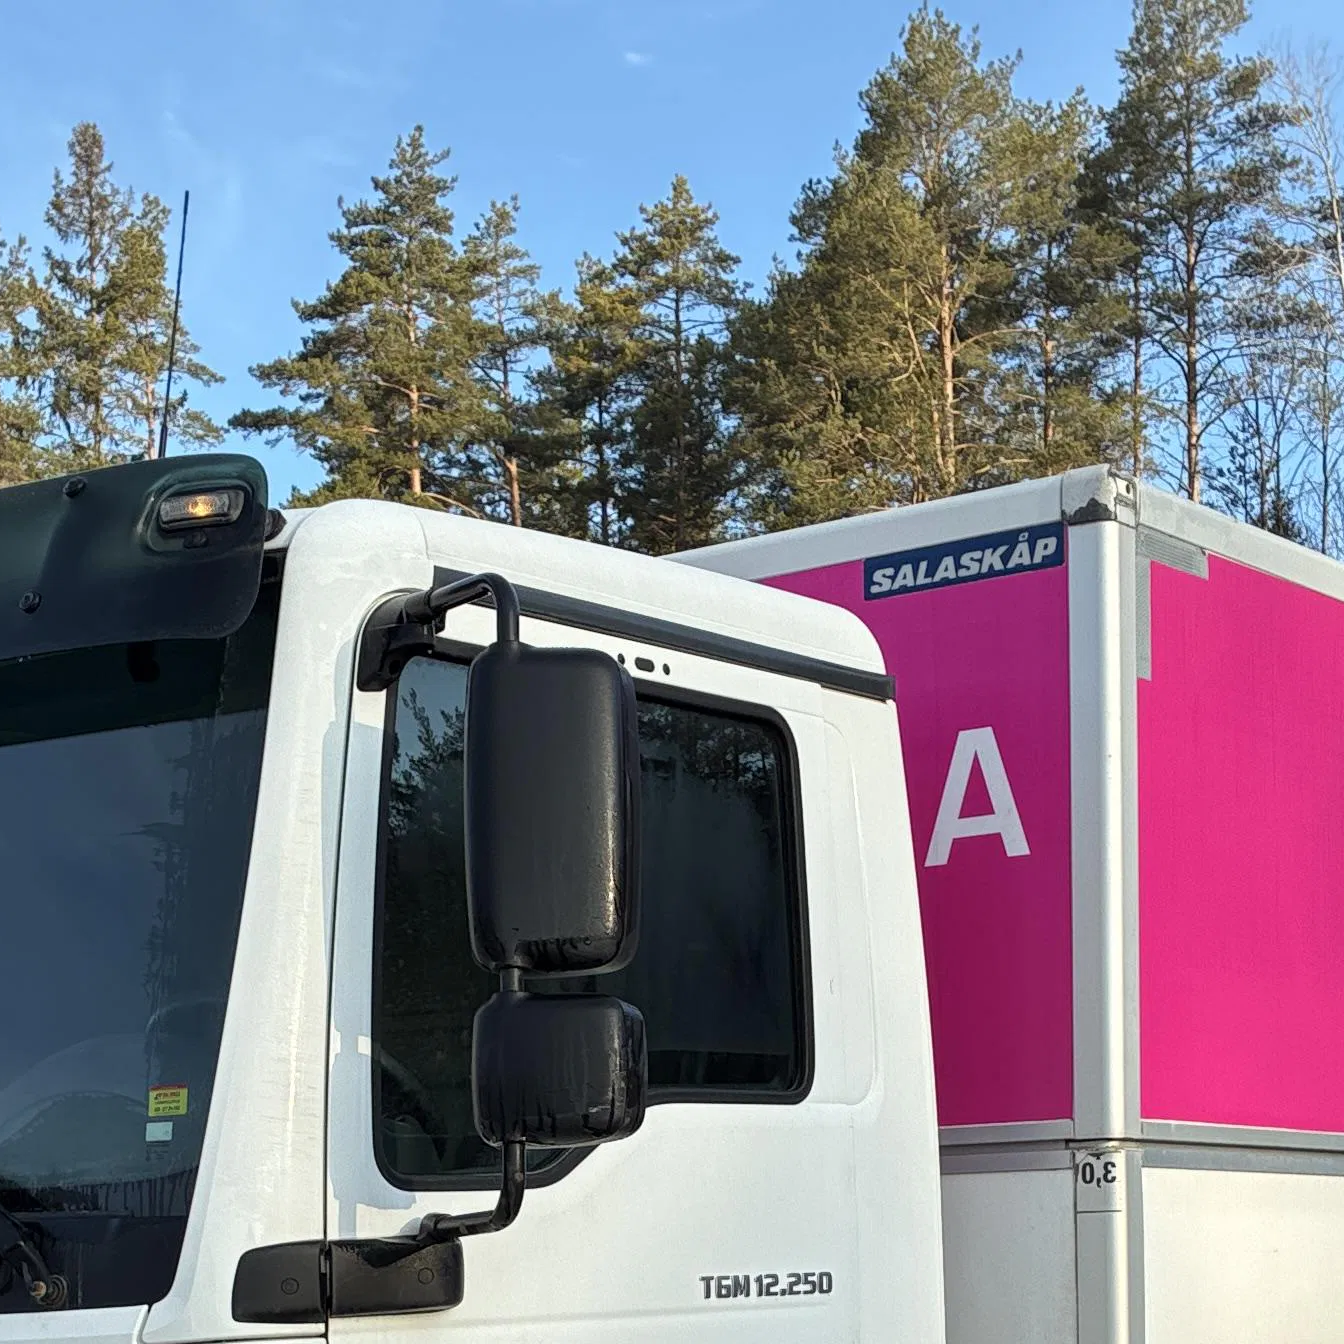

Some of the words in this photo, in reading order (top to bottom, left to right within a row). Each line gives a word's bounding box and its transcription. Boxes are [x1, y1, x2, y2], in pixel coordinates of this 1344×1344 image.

[869, 531, 1058, 595] SALASKÅP
[924, 725, 1032, 868] A
[699, 1275, 750, 1299] TGM
[753, 1271, 833, 1298] 12.250
